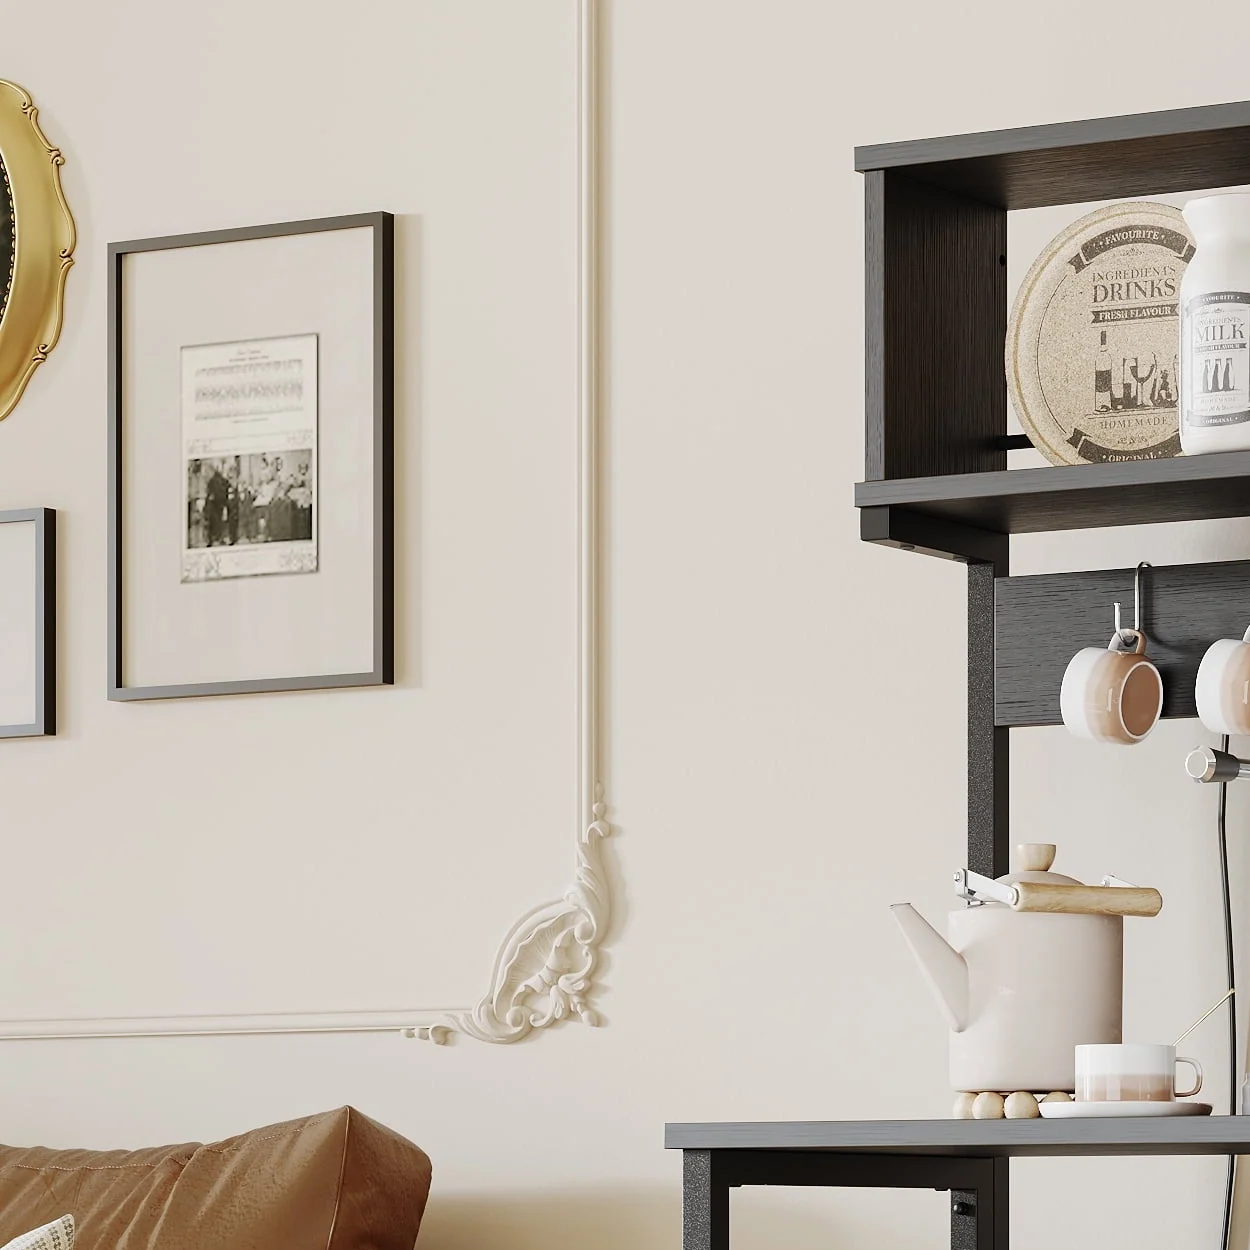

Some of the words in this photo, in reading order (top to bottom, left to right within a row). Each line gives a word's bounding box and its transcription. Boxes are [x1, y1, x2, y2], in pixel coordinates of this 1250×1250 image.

[1105, 230, 1160, 245] FAVOURITE
[1092, 265, 1176, 282] INGREDIENTS
[1091, 278, 1176, 303] DRINKS
[1100, 311, 1128, 320] FRESH
[1130, 306, 1171, 318] FLAVOUR
[1197, 322, 1245, 342] MILK
